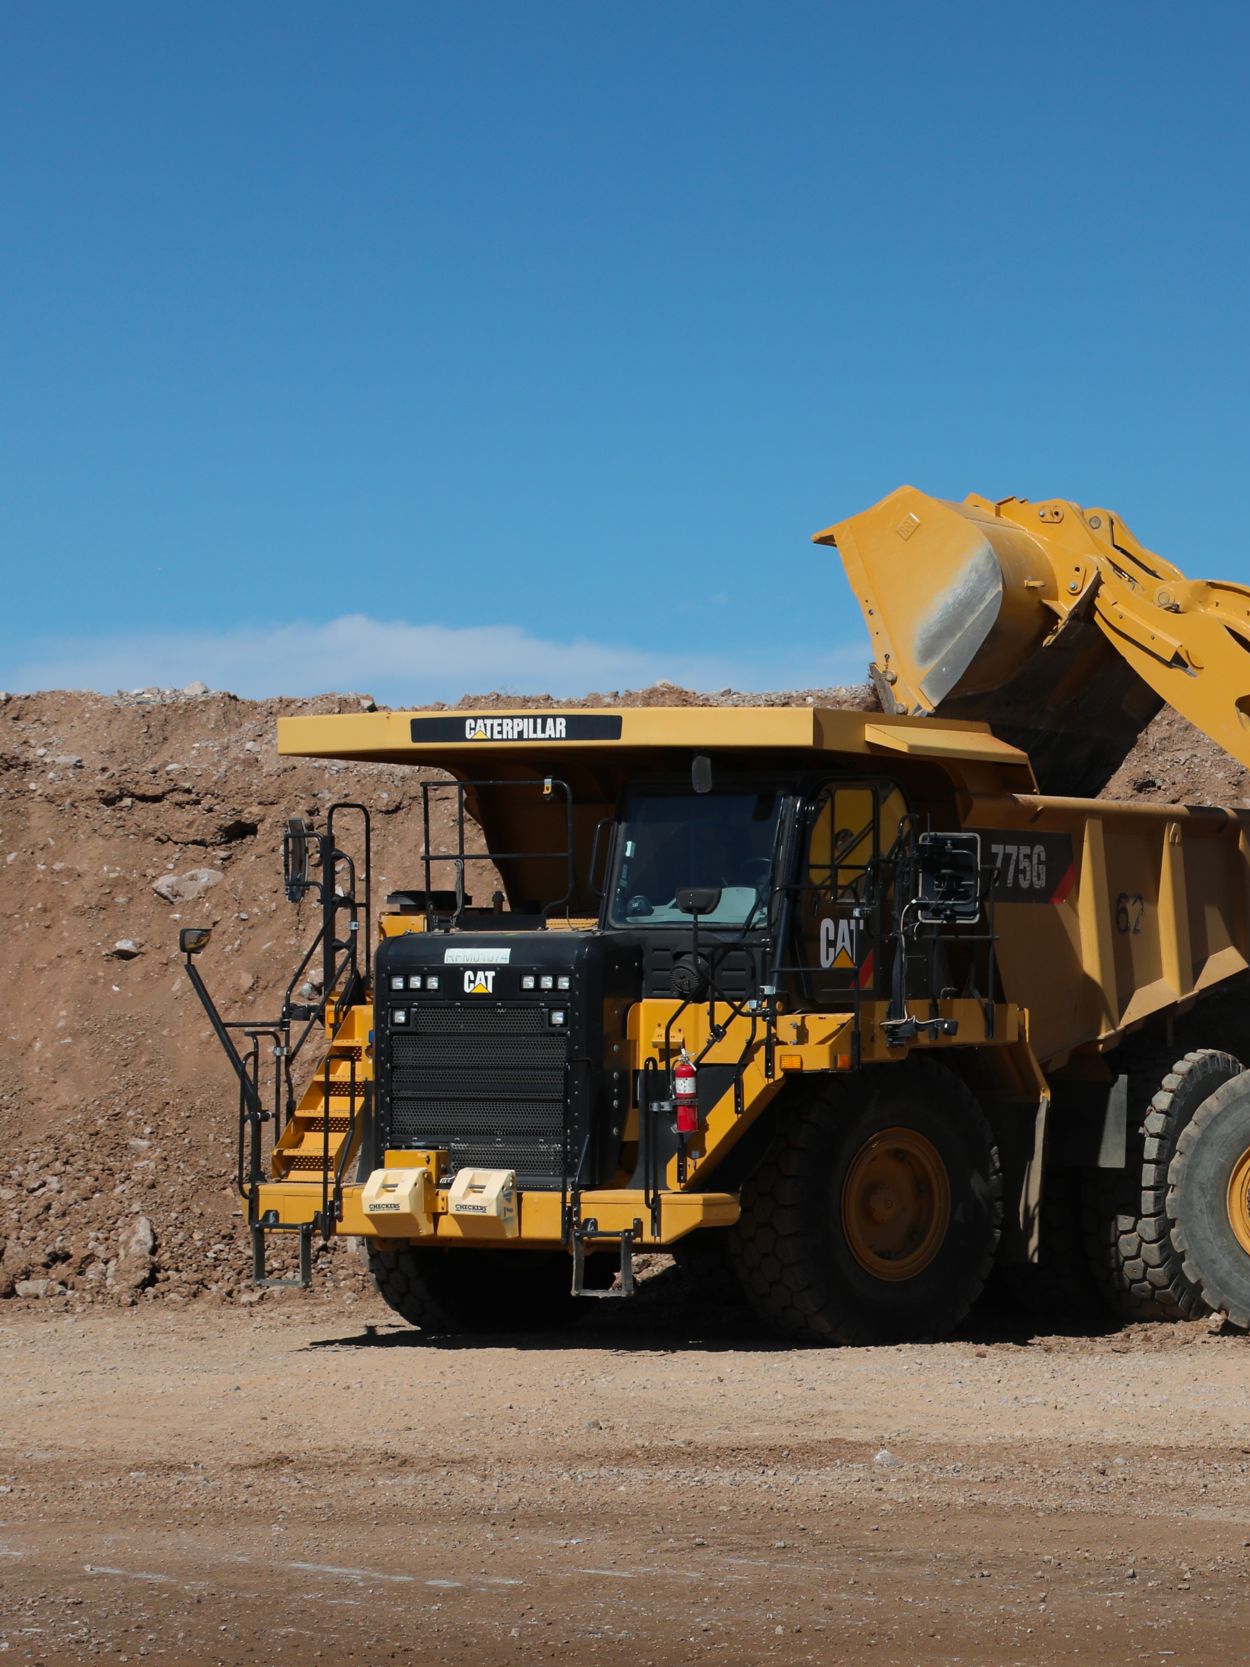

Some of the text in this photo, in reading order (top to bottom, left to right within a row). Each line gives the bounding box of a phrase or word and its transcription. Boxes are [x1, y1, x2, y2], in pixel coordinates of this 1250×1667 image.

[465, 717, 567, 740] CATERPILLAR
[991, 844, 1046, 888] 775G
[1116, 892, 1144, 934] 62
[463, 970, 496, 994] CAT
